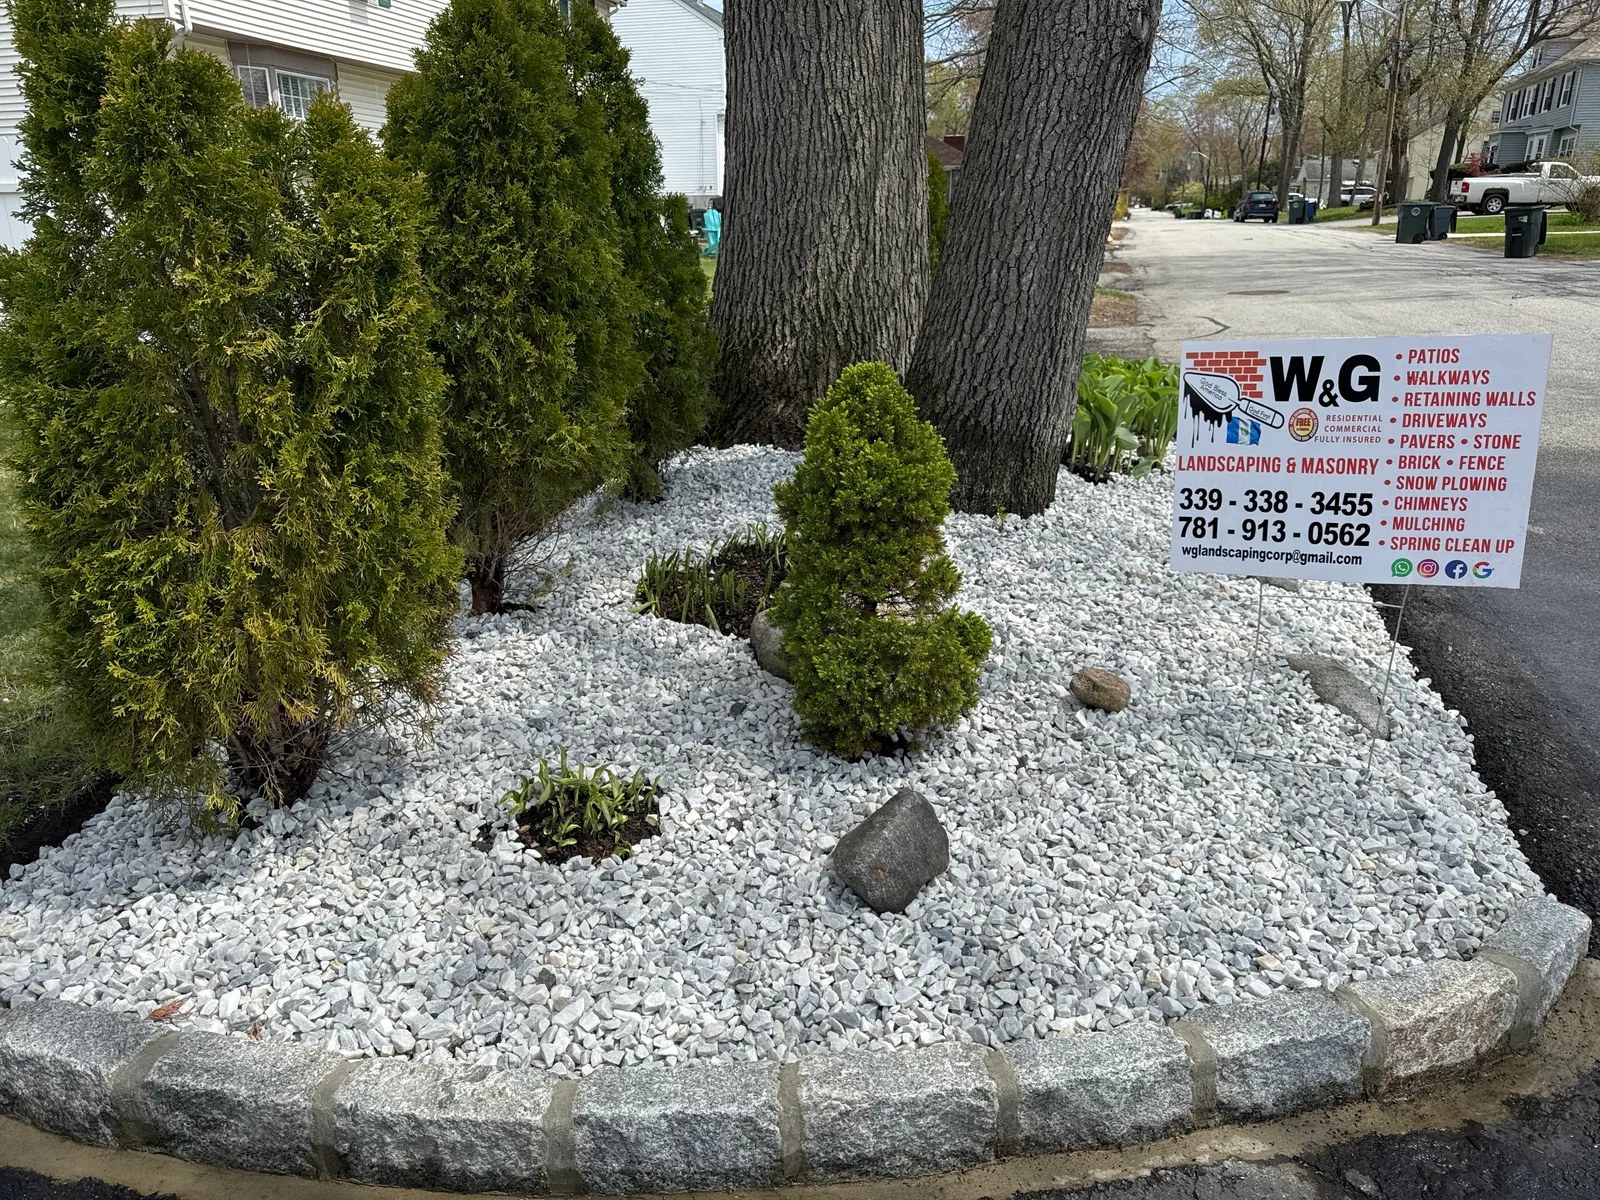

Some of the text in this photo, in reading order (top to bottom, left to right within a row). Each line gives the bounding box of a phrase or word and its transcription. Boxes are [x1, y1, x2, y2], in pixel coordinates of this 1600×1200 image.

[1408, 348, 1460, 364] PATIOS
[1269, 354, 1381, 407] W&G
[1406, 370, 1490, 385] WALKWAYS
[1200, 384, 1223, 401] America
[1404, 391, 1536, 407] RETAINING WALLS
[1296, 417, 1311, 426] FREE
[1326, 414, 1383, 422] RESIDENTIAL
[1402, 413, 1488, 428] DRIVEWAYS
[1324, 425, 1382, 433] COMMERCIAL
[1314, 435, 1340, 443] FULLY
[1342, 435, 1381, 443] INSURED
[1400, 434, 1522, 449] PAVERS STONE
[1178, 455, 1379, 475] LANDSCAPING & MASONRY
[1398, 455, 1506, 471] BRICK FENCE
[1396, 476, 1507, 492] SNOW PLOWING
[1179, 487, 1223, 511] 339
[1243, 489, 1288, 513] 338
[1309, 491, 1373, 517] 3455
[1394, 496, 1468, 512] CHIMNEYS
[1178, 516, 1219, 539] 781
[1241, 518, 1286, 543] 913
[1308, 521, 1371, 547] 0562
[1392, 516, 1465, 532] MULCHING
[1390, 536, 1515, 554] SPRING CLEAN UP
[1181, 544, 1362, 565] wglandscapingcorp@gmail.com
